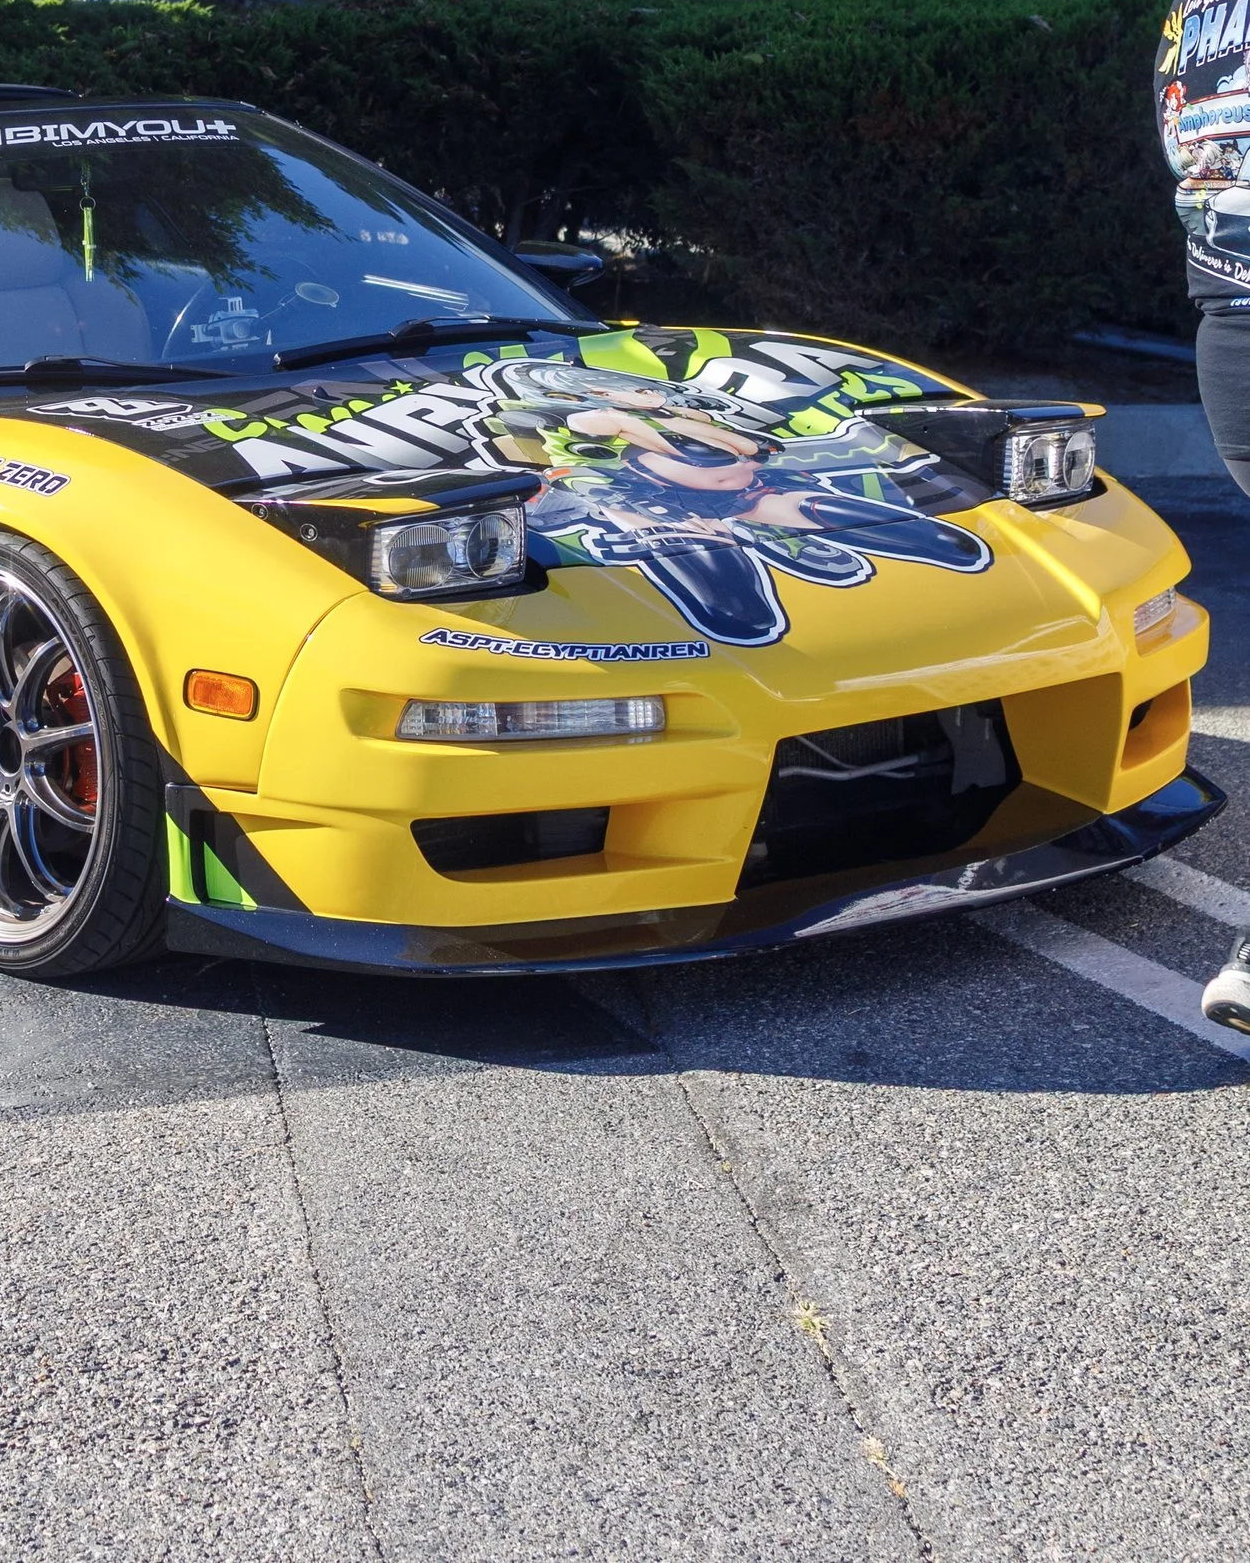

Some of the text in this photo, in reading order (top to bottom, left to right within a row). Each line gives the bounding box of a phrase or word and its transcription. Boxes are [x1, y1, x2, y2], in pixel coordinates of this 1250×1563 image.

[52, 133, 240, 148] LOS ANGELES CALIFORNIA
[421, 628, 708, 660] ASPT-EGYPTIANREN
